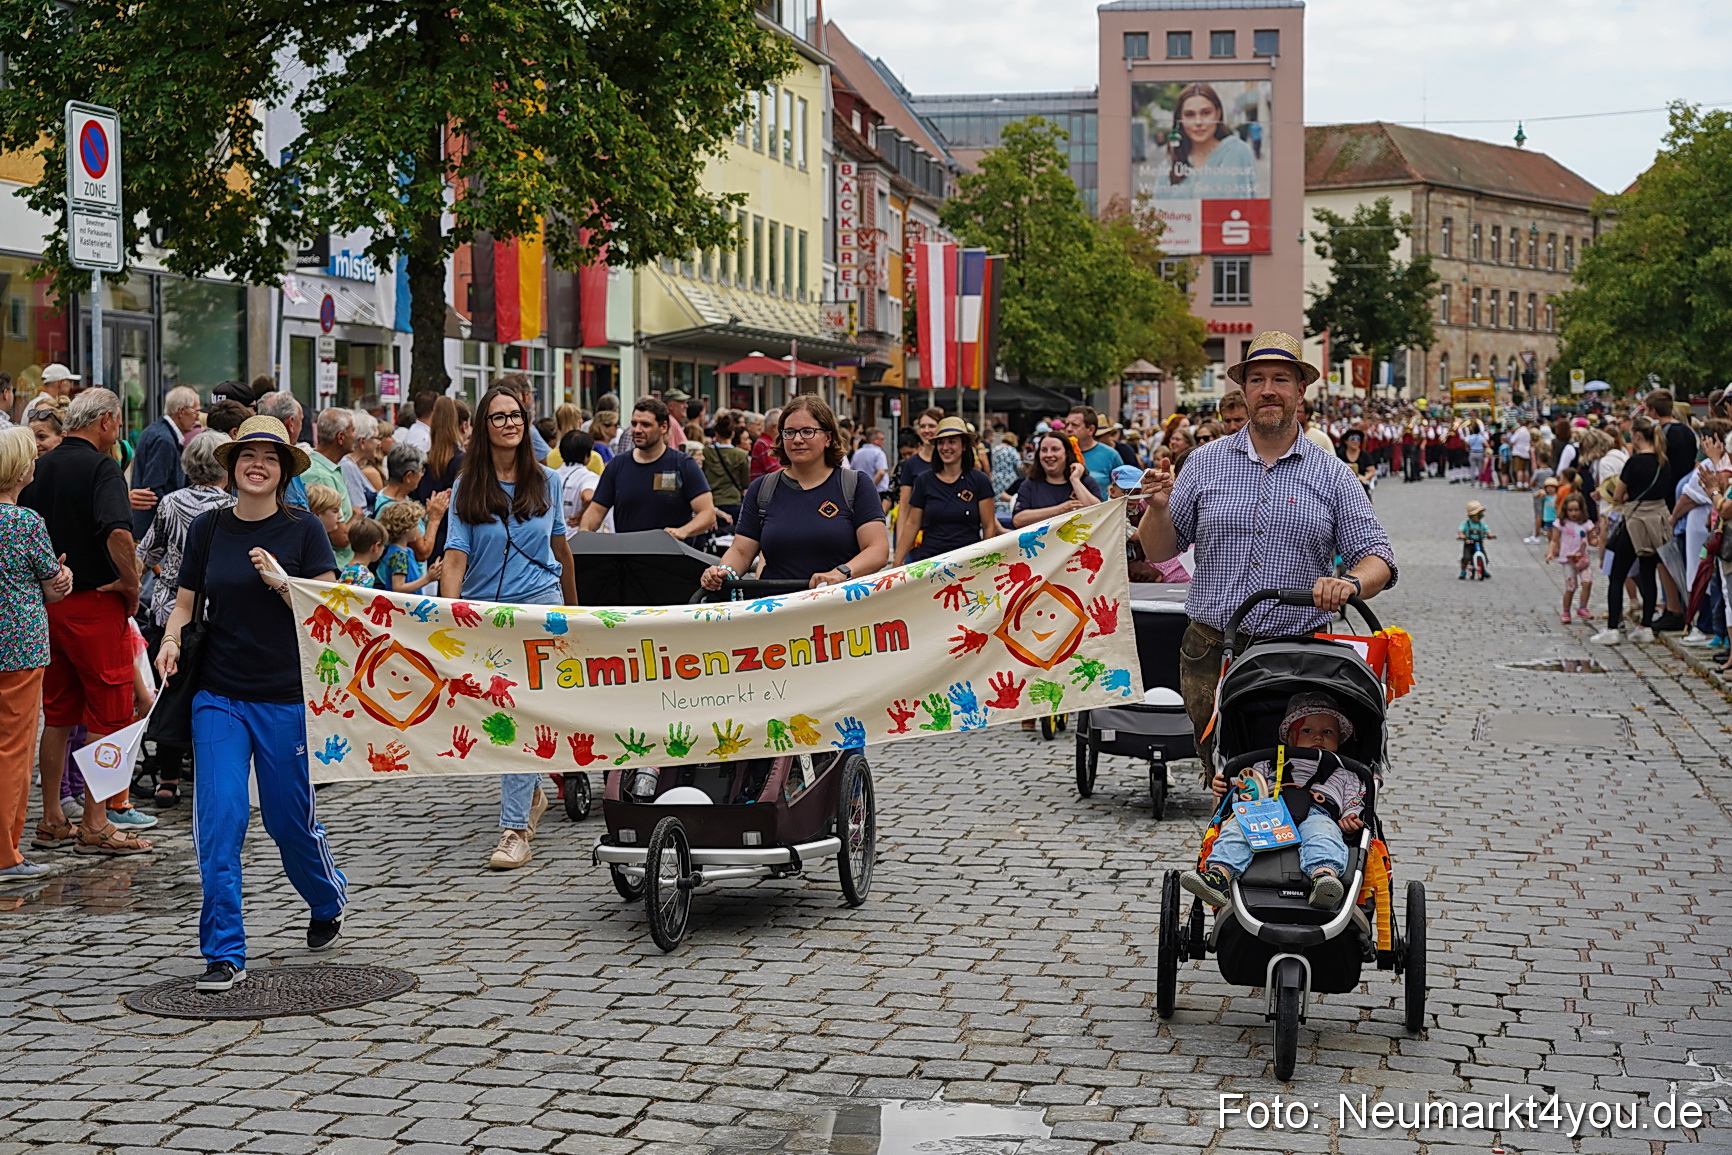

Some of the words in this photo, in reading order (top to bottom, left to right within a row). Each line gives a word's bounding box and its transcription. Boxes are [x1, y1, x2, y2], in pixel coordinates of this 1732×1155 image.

[84, 181, 107, 199] ZONE
[85, 218, 106, 228] Bewohner
[79, 236, 112, 249] Kastenviertel
[91, 249, 102, 259] frei
[335, 250, 376, 282] miste
[1206, 319, 1254, 334] rkasse
[523, 618, 910, 690] Familienzentrum
[661, 683, 755, 711] Neumarkt
[764, 679, 788, 701] e.V.
